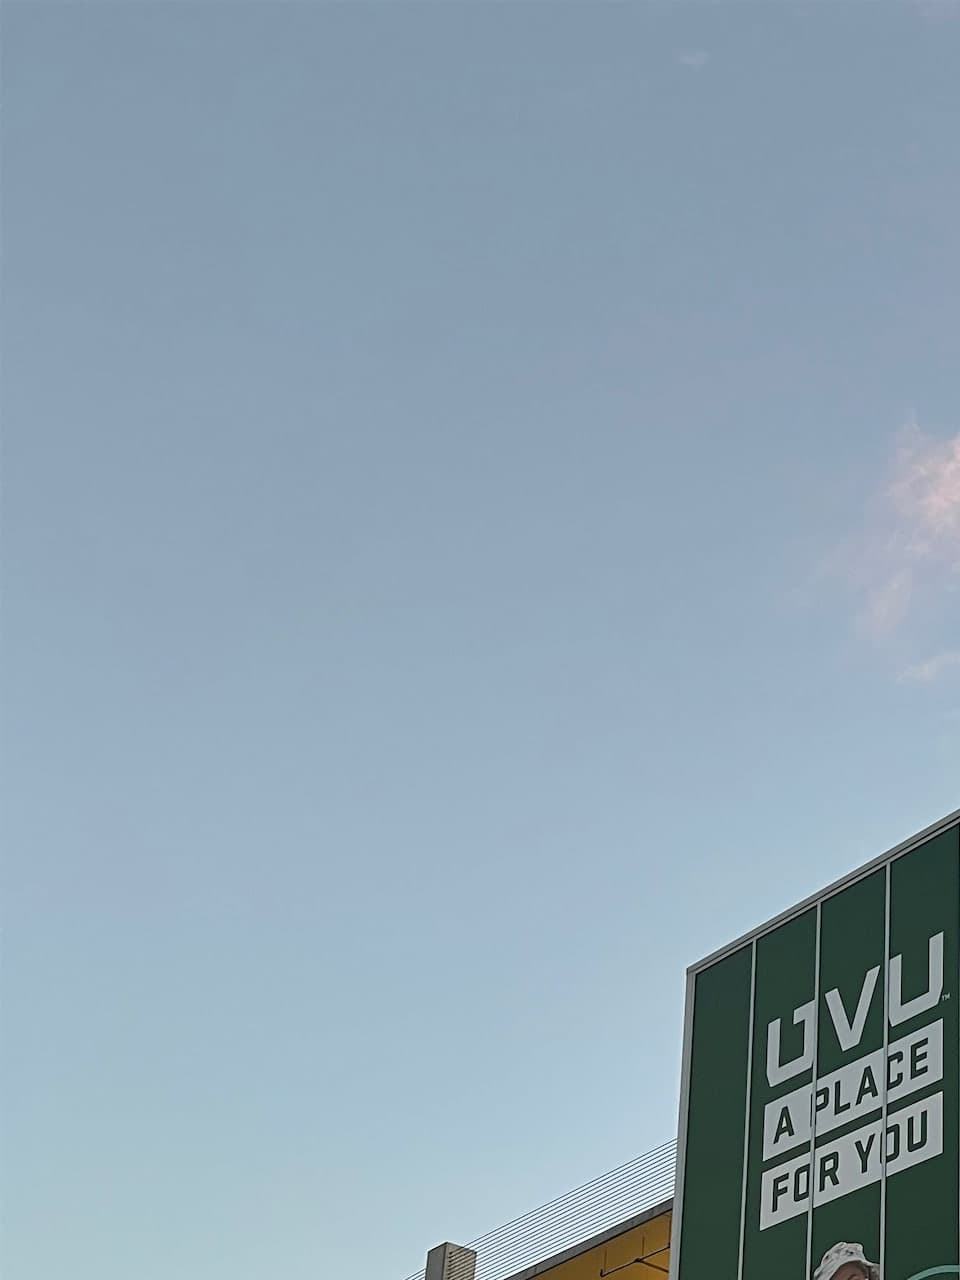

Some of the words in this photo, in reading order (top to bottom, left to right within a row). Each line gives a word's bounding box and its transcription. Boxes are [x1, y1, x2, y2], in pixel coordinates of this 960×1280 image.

[766, 931, 944, 1087] UVU
[773, 1106, 795, 1145] A
[810, 1037, 929, 1128] PLACE
[771, 1151, 840, 1213] FOR
[854, 1110, 928, 1174] YOU
